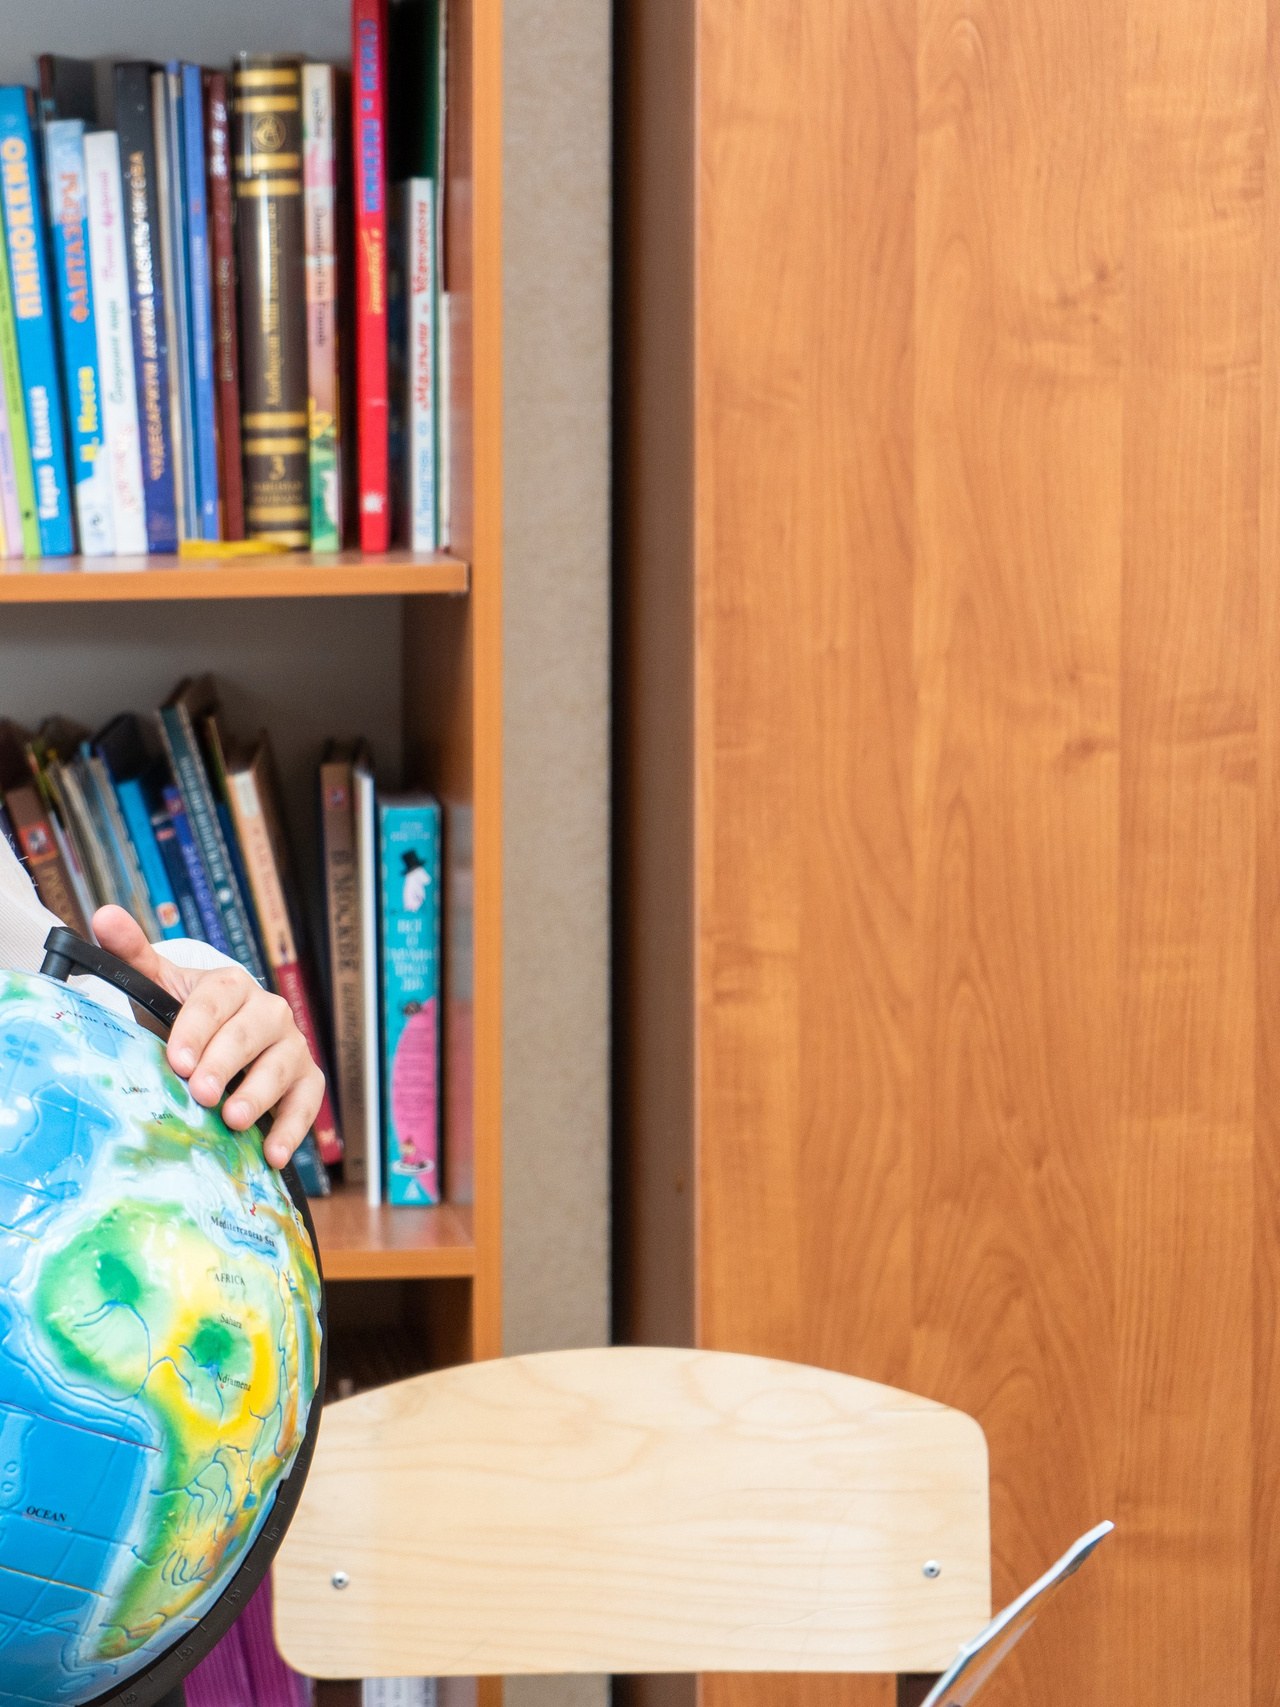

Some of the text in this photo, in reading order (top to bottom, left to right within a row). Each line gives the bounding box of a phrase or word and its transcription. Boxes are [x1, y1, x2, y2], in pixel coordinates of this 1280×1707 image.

[360, 19, 377, 91] СТИХИ
[362, 118, 380, 212] ПЕСЕНКИ
[1, 137, 42, 318] ПИНОККИО
[30, 385, 54, 460] Коллоди
[72, 365, 99, 433] Носов
[36, 466, 62, 518] Карло
[151, 1111, 174, 1120] Paris
[214, 1272, 246, 1286] AFRICA
[220, 1312, 243, 1330] Sahara
[216, 1371, 252, 1392] Ndjamena
[26, 1505, 68, 1522] OCEAN
